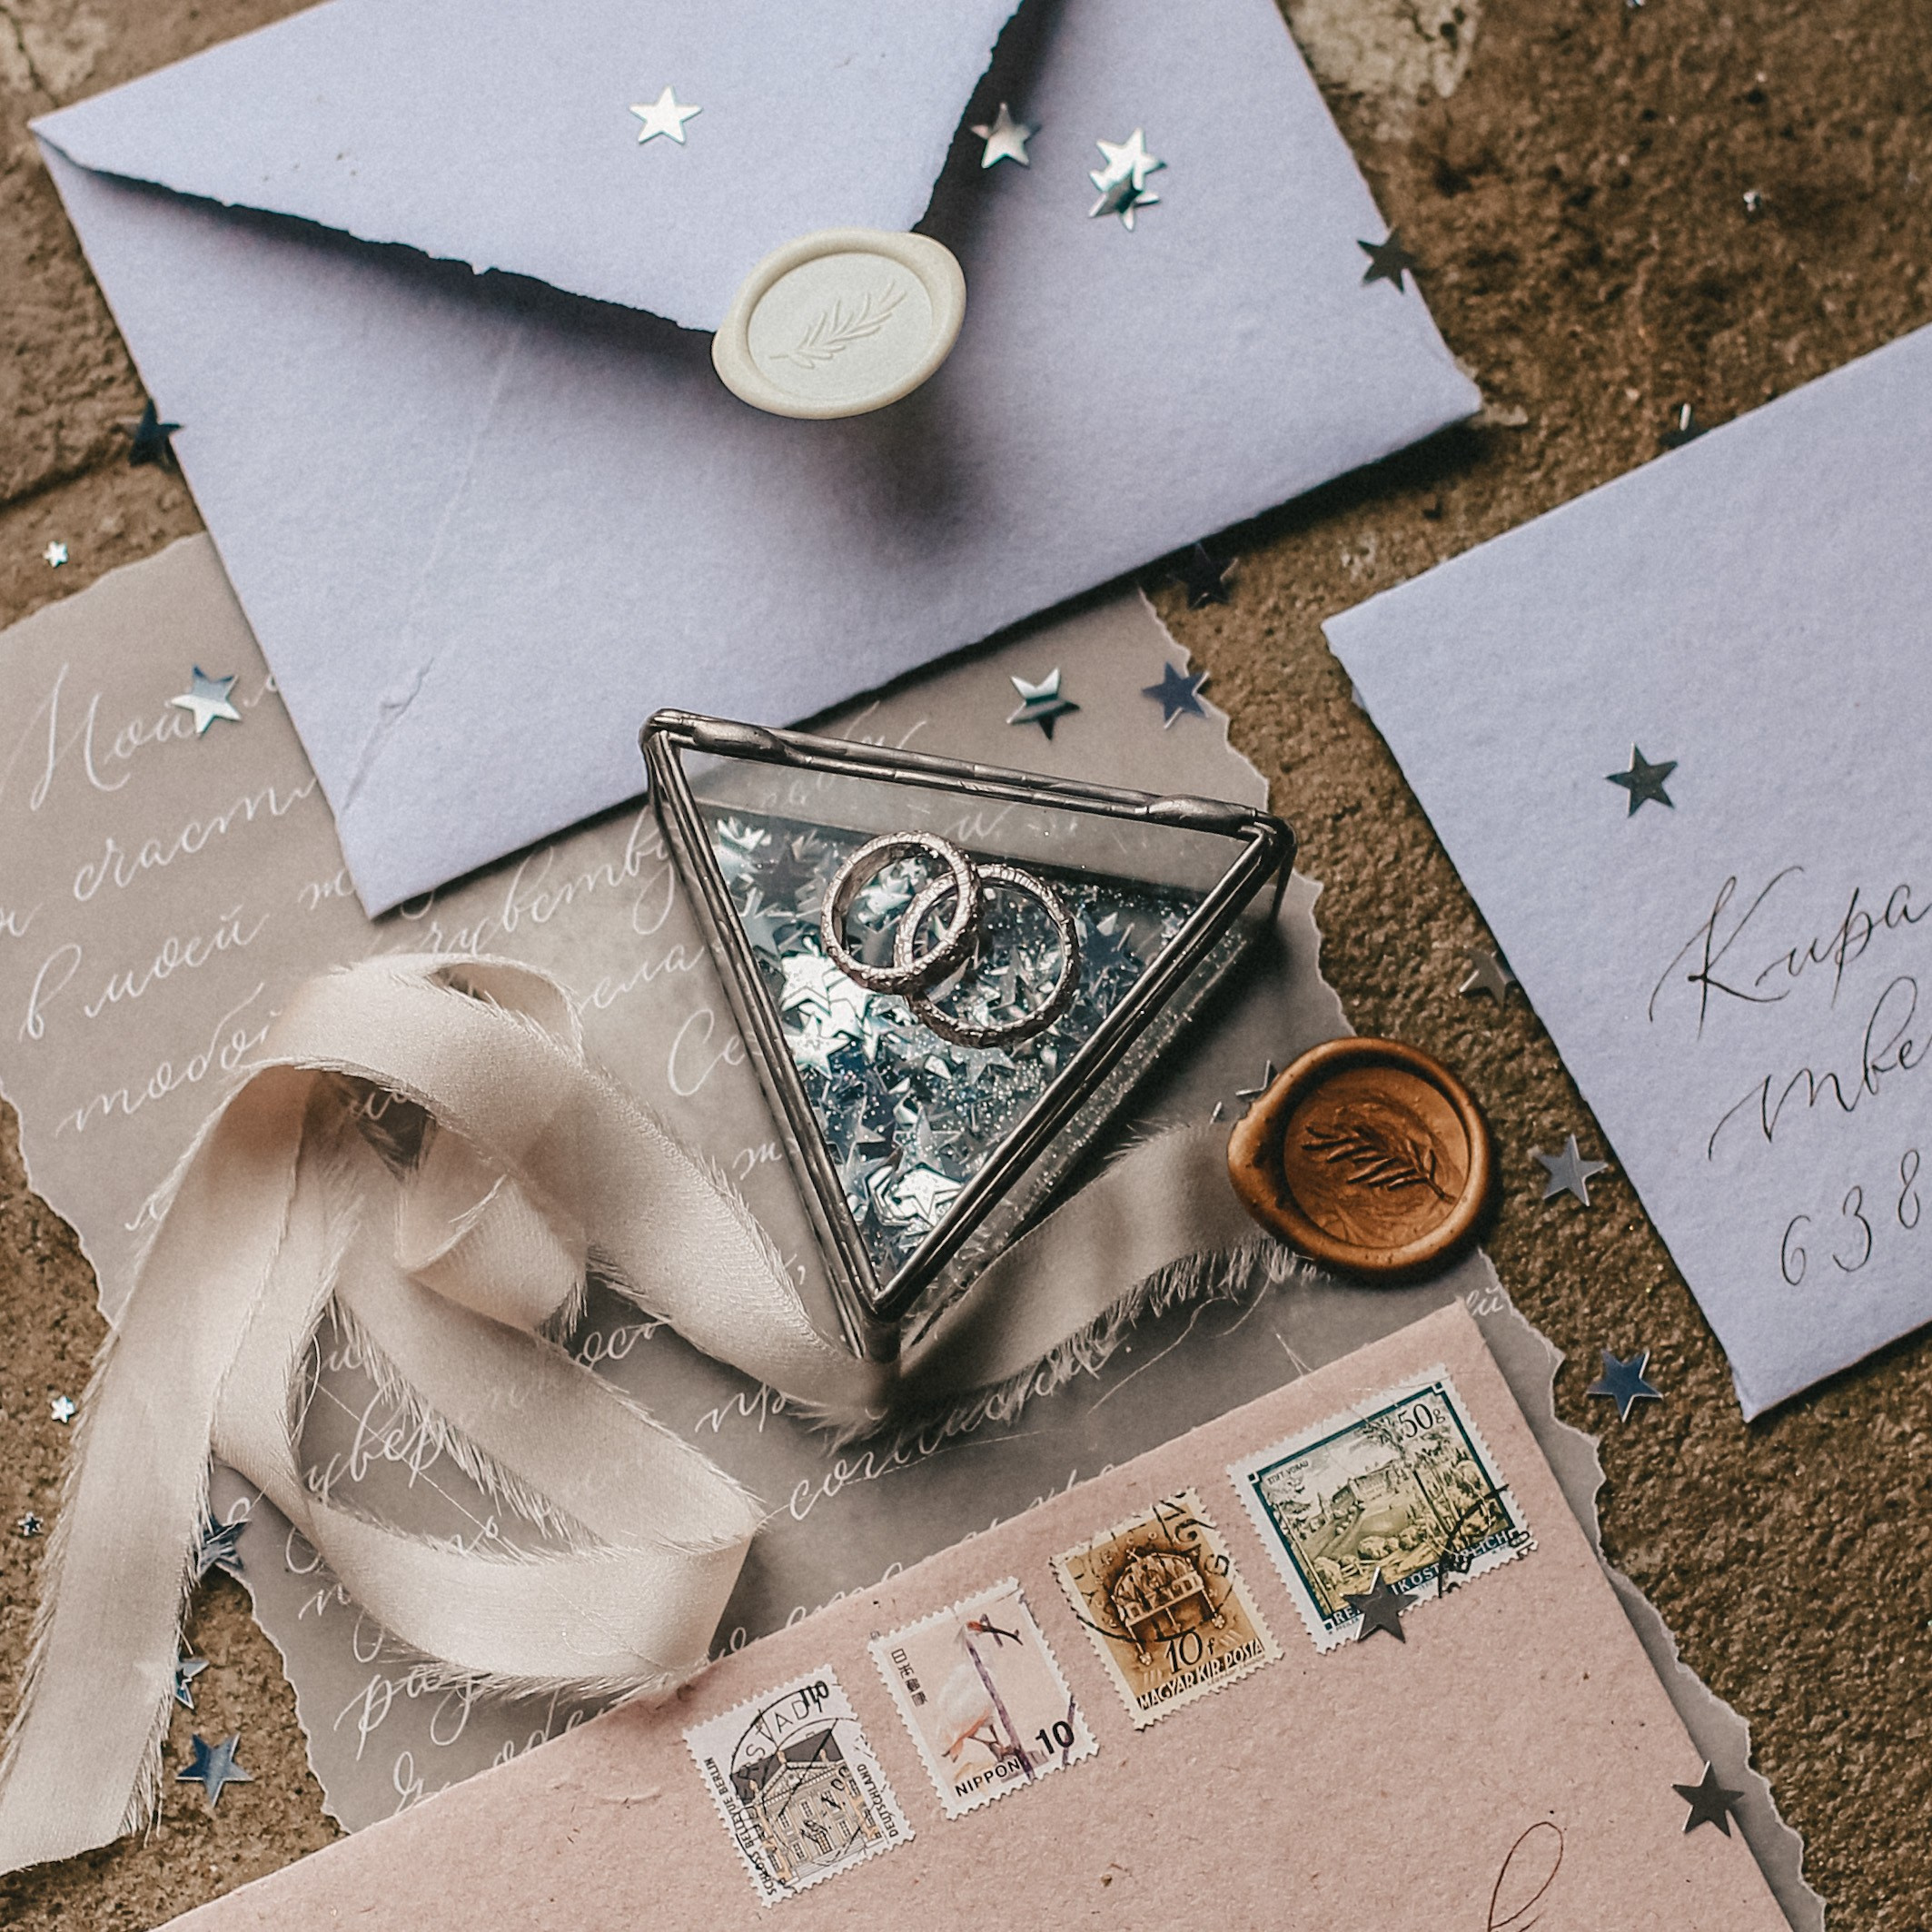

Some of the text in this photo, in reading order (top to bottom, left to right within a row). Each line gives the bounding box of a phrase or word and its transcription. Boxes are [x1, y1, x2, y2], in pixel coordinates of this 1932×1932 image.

[1165, 1631, 1204, 1674] 10
[1139, 1673, 1196, 1709] MAGYAR
[1035, 1720, 1075, 1755] 10
[703, 1756, 728, 1797] BERLIN
[955, 1758, 1021, 1797] NIPPON
[857, 1763, 899, 1838] DEUTSCHLAND
